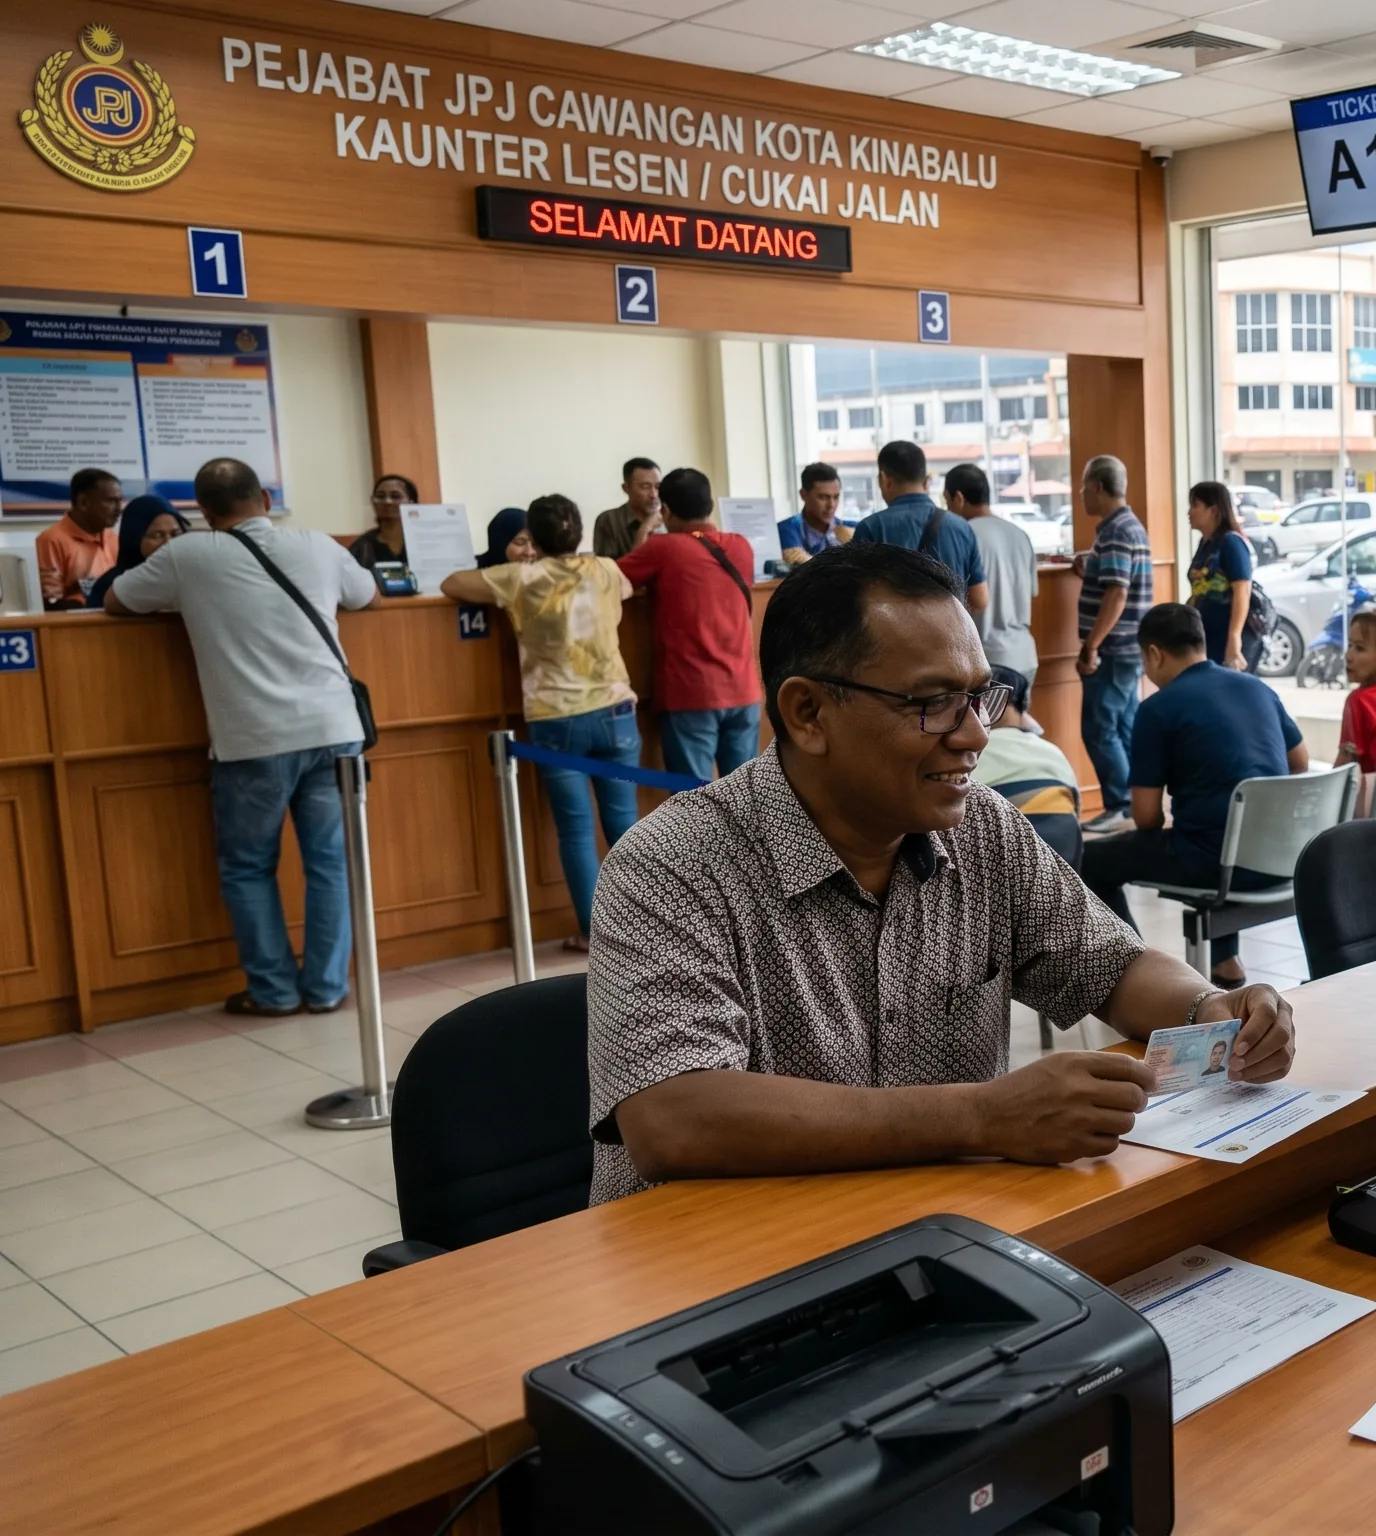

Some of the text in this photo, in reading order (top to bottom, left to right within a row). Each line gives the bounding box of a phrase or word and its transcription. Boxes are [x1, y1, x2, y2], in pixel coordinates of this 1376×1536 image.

[82, 86, 133, 128] JPJ
[222, 37, 998, 190] PEJABAT JPJ CAWANGAN KOTA KINABALU
[335, 112, 939, 229] KAUNTER LESEN / CUKAI JALAN
[530, 200, 818, 260] SELAMAT DATANG
[204, 241, 229, 286] 1
[625, 276, 650, 313] 2
[925, 301, 944, 334] 3
[460, 610, 486, 634] 14
